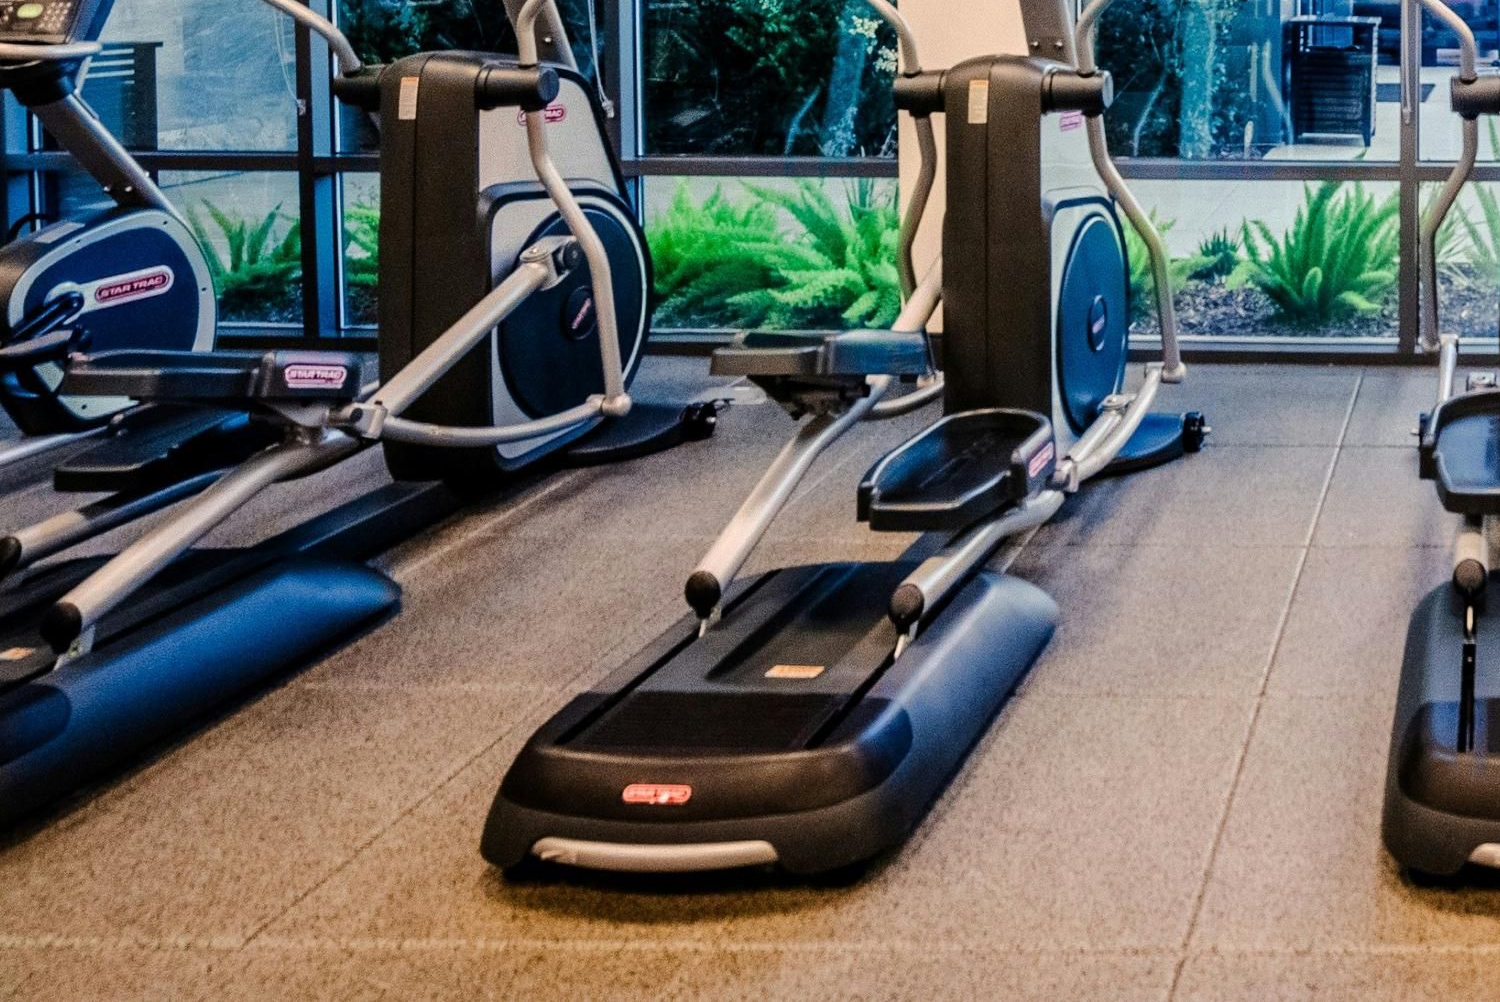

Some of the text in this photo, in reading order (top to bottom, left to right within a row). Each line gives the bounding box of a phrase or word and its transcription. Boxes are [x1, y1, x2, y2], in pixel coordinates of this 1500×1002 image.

[101, 276, 164, 297] STAR TRAC
[290, 370, 342, 379] STAR TRAC
